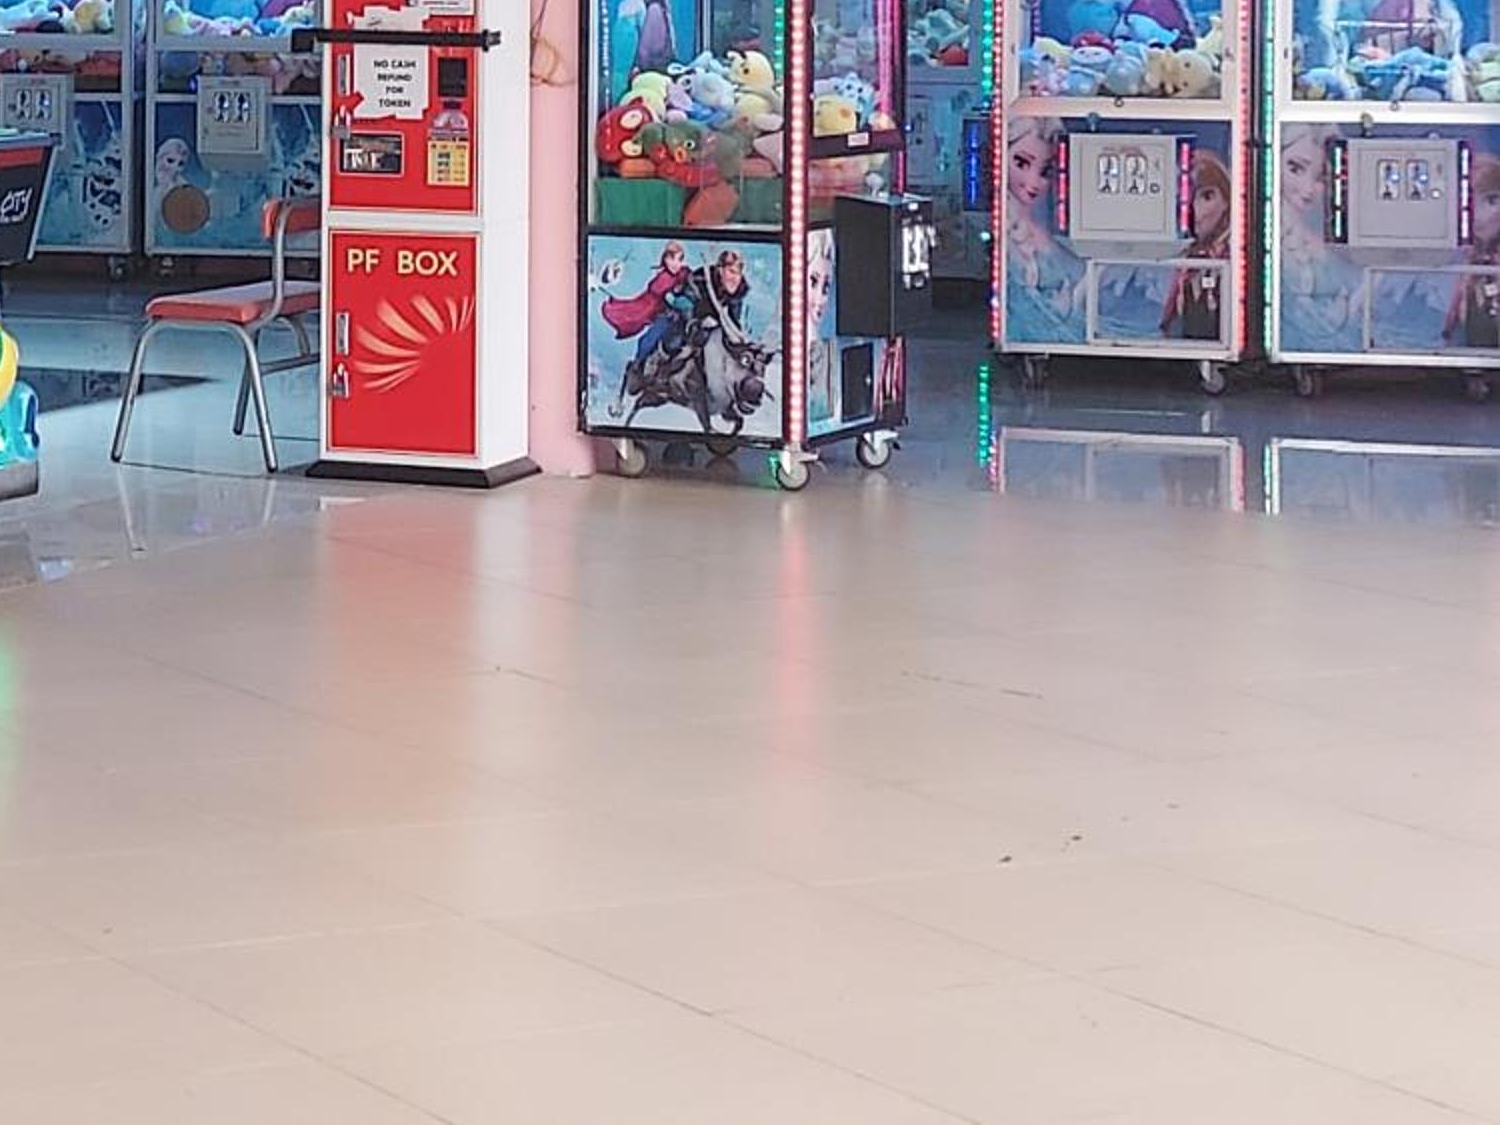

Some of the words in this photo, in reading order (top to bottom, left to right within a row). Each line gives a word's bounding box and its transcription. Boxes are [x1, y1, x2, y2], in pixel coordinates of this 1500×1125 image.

[374, 59, 389, 68] NO
[377, 73, 412, 82] REFUND
[386, 86, 404, 95] FOR
[379, 98, 411, 108] TOKEN
[347, 248, 380, 273] PF
[397, 250, 457, 276] BOX
